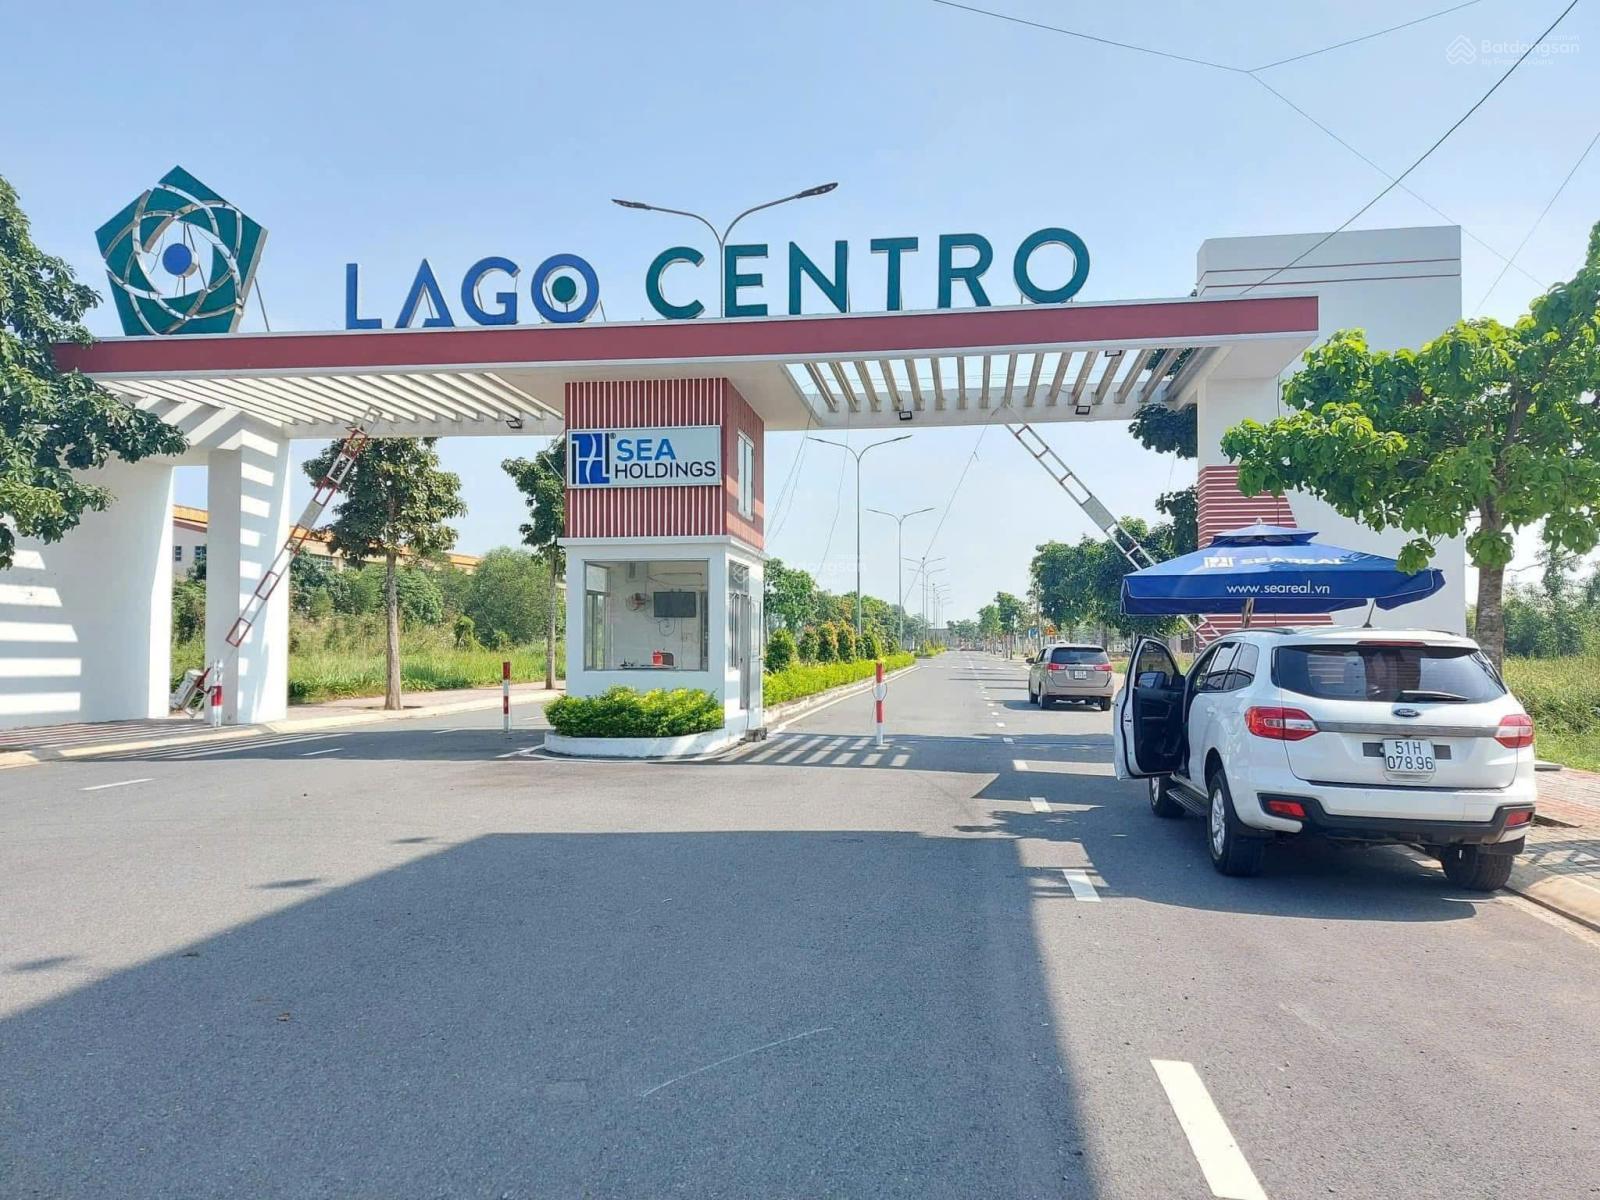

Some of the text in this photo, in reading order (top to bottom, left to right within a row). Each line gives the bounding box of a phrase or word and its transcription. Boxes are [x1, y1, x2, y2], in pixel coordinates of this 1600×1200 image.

[345, 226, 1091, 330] LAGO CENTRO
[616, 438, 676, 462] SEA
[614, 461, 716, 479] HOLDINGS
[1226, 580, 1331, 595] www.seareal.vn
[1395, 741, 1422, 755] 51H
[1387, 755, 1434, 770] 078.96
